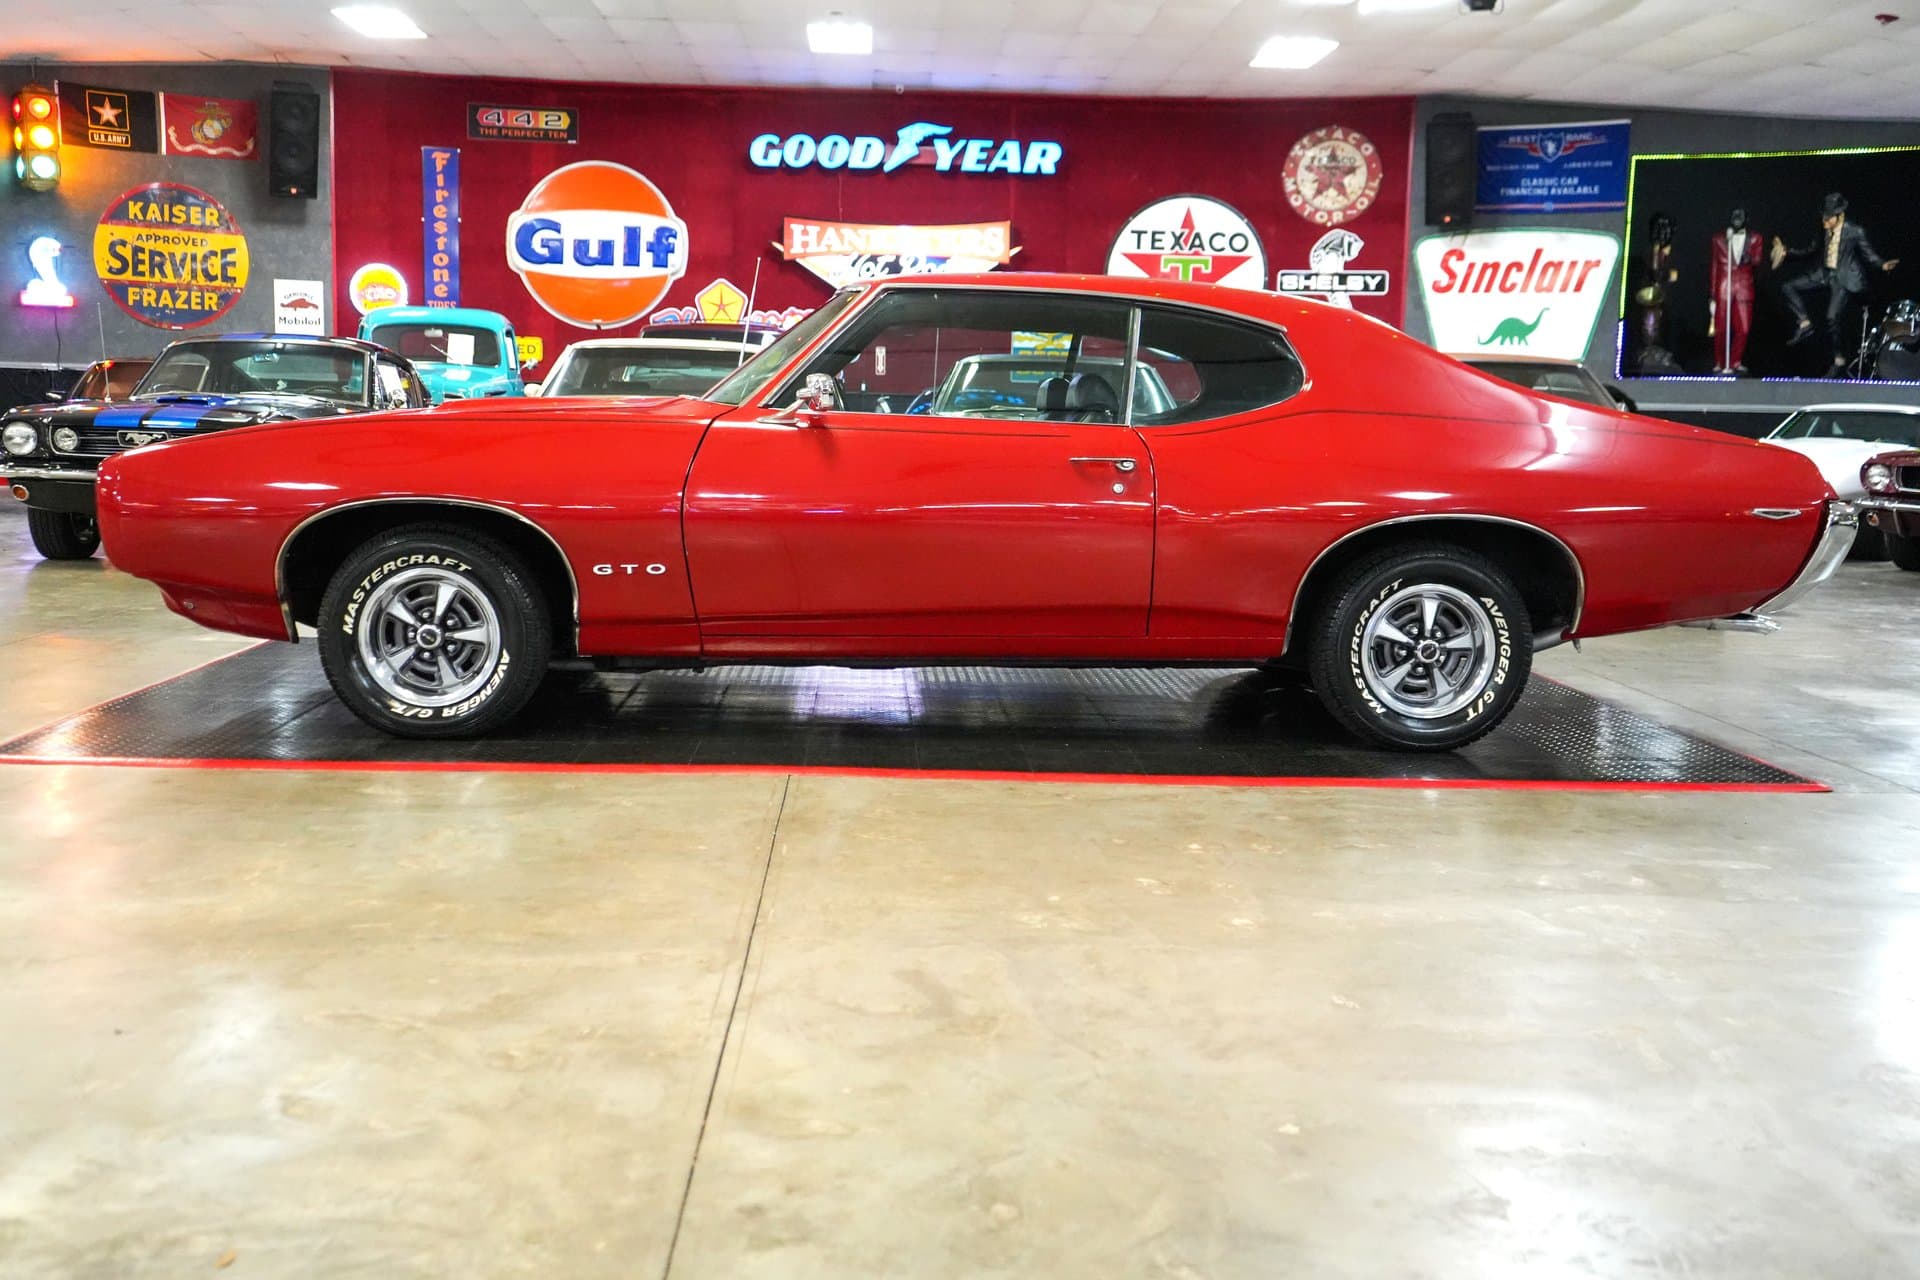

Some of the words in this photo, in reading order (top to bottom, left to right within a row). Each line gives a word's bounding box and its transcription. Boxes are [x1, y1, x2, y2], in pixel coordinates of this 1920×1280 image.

[484, 109, 564, 129] 442
[108, 134, 127, 144] ARMY
[480, 128, 498, 136] THE
[502, 128, 546, 138] PERFECT
[548, 130, 568, 139] TEN
[1501, 186, 1548, 197] FINANCING
[1550, 185, 1600, 195] AVAILABLE
[1521, 177, 1559, 187] CLASSIC
[1560, 176, 1580, 186] CAR
[128, 200, 220, 227] KAISER
[431, 151, 451, 299] Firestone
[136, 232, 209, 248] APPROVED
[514, 218, 678, 268] Gulf
[1131, 229, 1250, 254] TEXACO
[106, 238, 237, 284] SERVICE
[1162, 257, 1211, 282] T
[1431, 248, 1602, 294] Sinclair
[1281, 274, 1383, 291] SHELBY
[128, 289, 219, 311] FRAZER
[278, 316, 321, 326] Mobiloil
[592, 563, 667, 576] GTO
[342, 554, 472, 636] MASTERCRAFT
[1350, 578, 1403, 715] MASTERCRAFT
[1480, 596, 1511, 685] AVENGER
[441, 648, 510, 718] AVENGER
[1466, 691, 1496, 721] G/T
